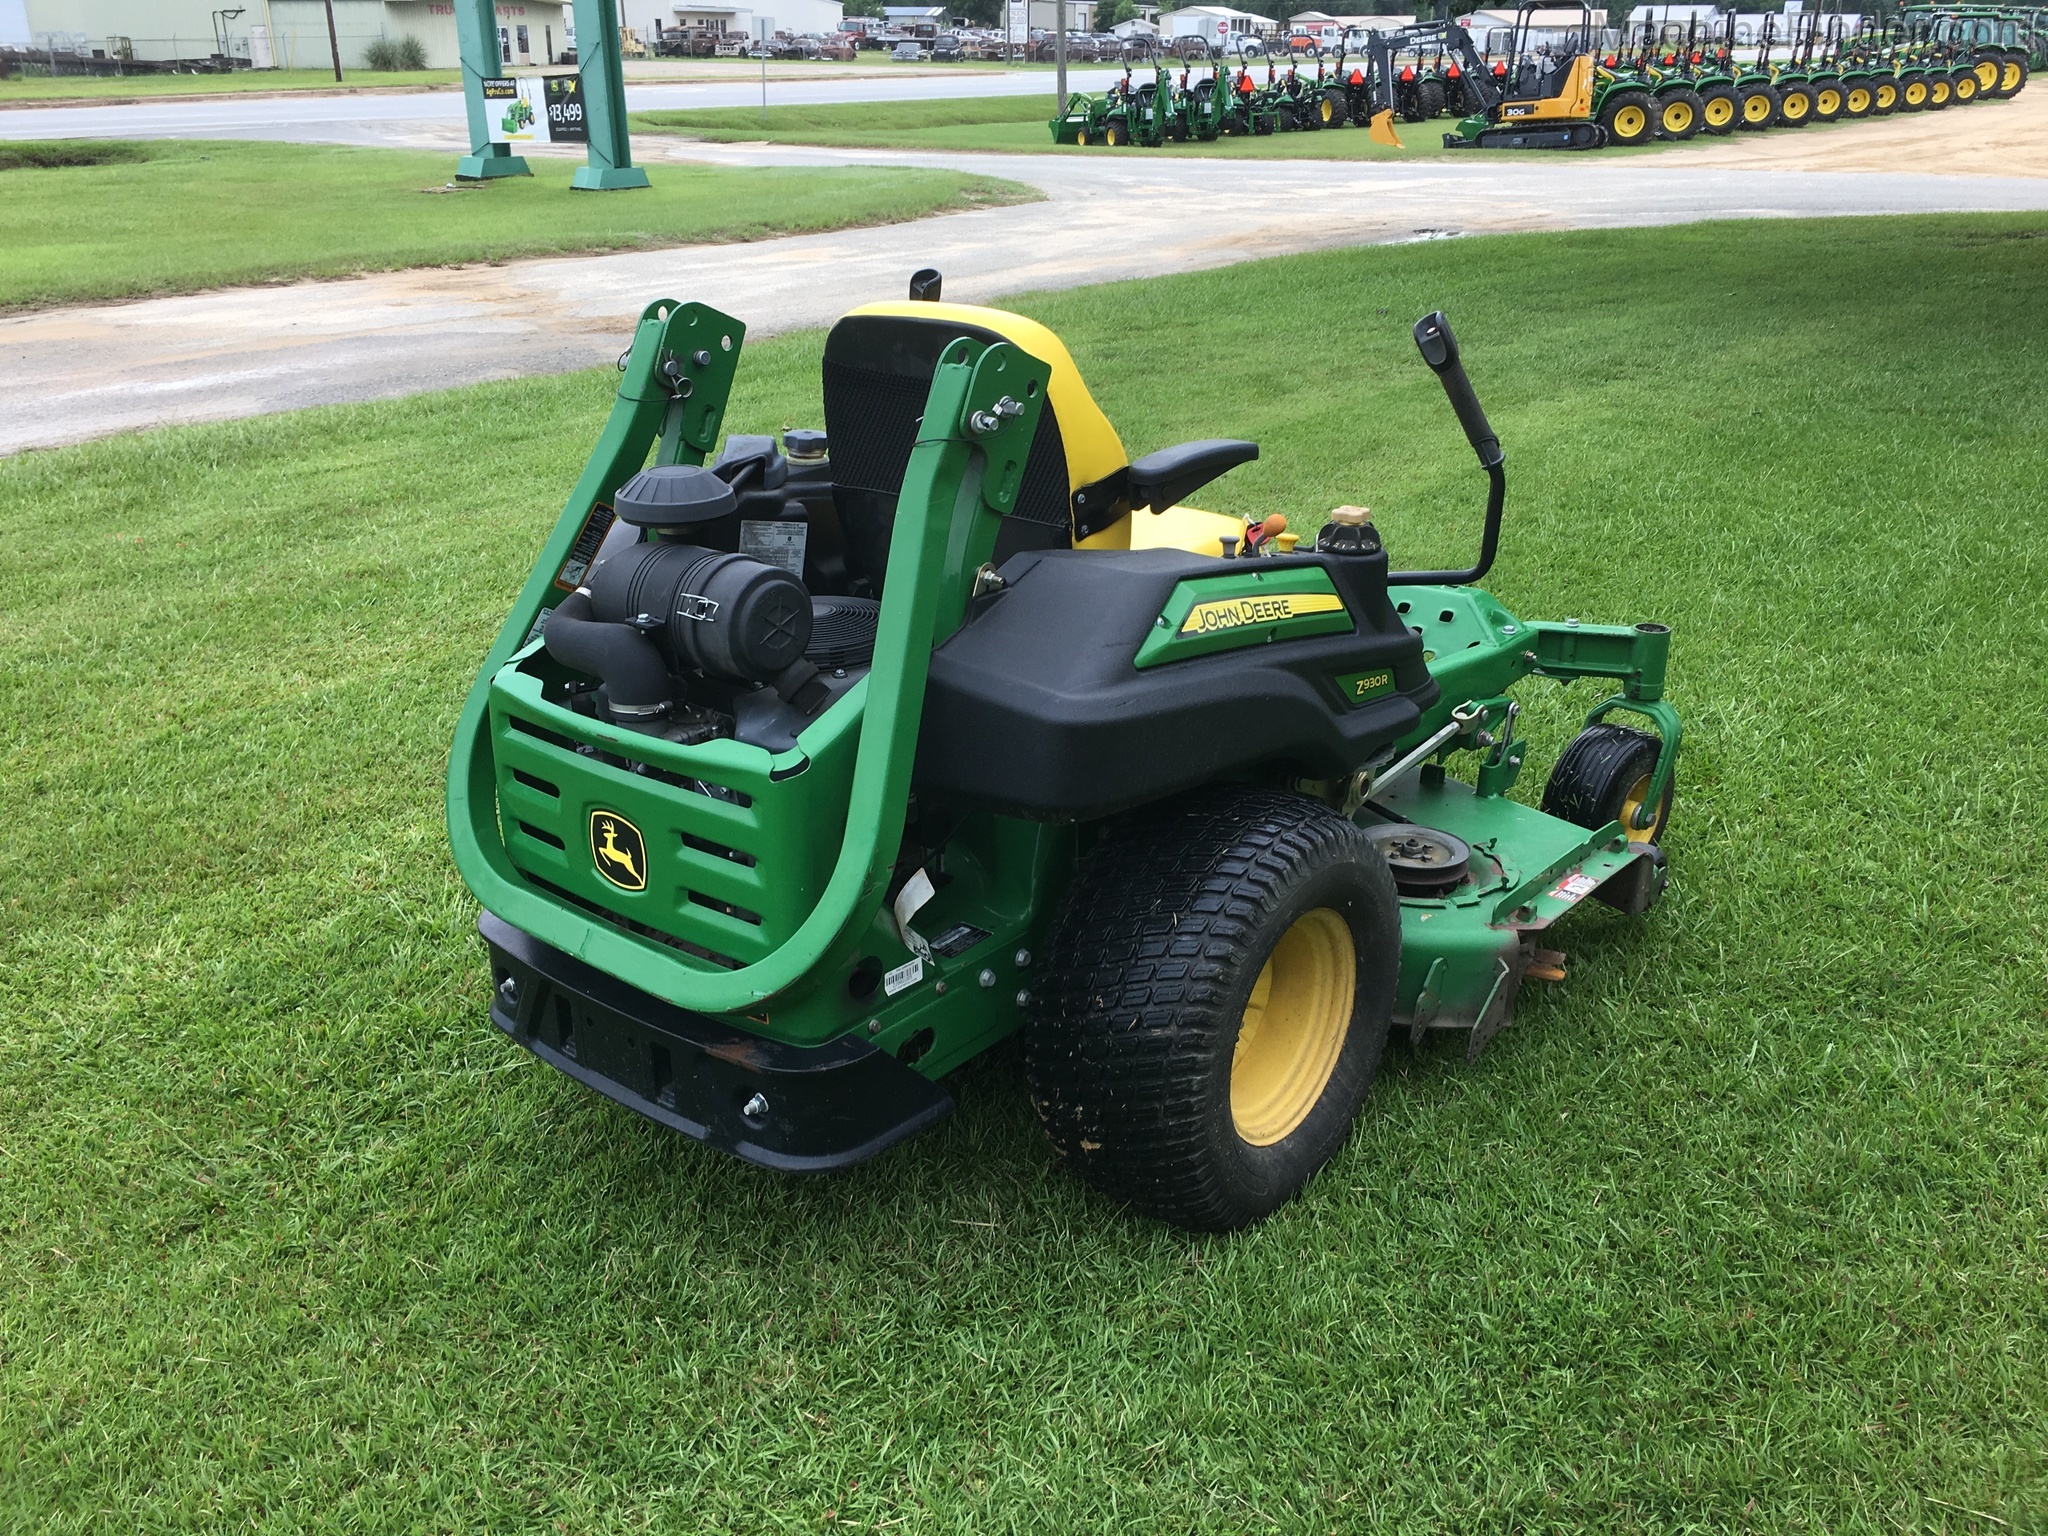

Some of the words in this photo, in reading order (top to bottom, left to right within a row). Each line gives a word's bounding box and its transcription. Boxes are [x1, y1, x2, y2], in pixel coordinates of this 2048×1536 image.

[428, 5, 455, 15] TRU
[1410, 34, 1437, 45] DEERE
[549, 103, 582, 124] $13,499
[1506, 108, 1525, 116] 30G
[1198, 606, 1240, 630] JOHN
[1240, 599, 1293, 621] DEERE
[1356, 673, 1388, 695] Z930R
